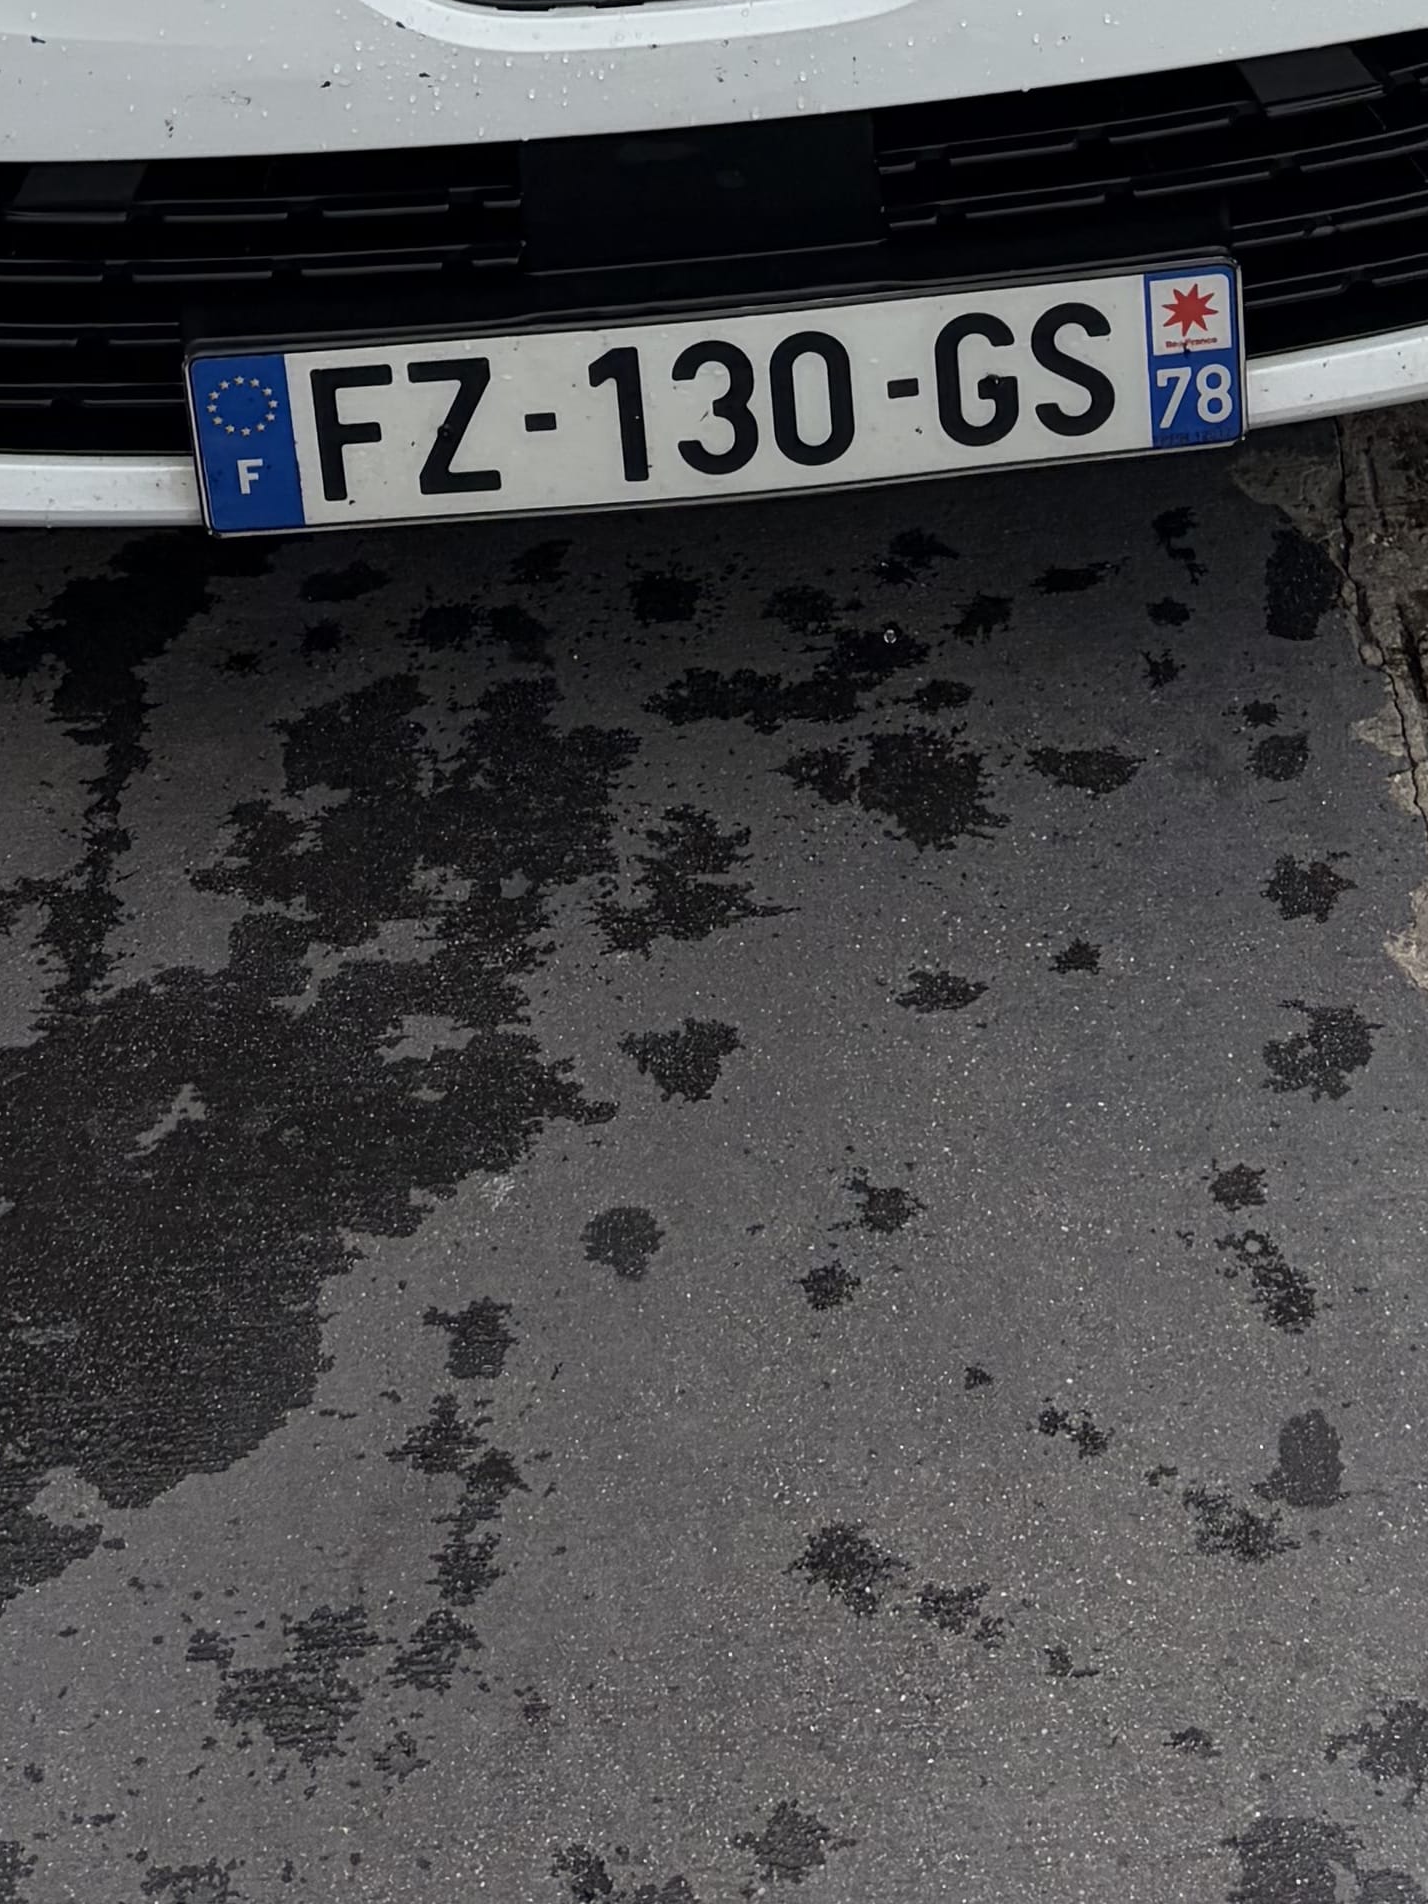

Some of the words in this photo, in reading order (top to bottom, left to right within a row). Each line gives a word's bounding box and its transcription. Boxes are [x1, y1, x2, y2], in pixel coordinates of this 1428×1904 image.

[239, 458, 263, 496] F
[310, 301, 1116, 502] FZ-130-GS
[1156, 363, 1233, 429] 78
